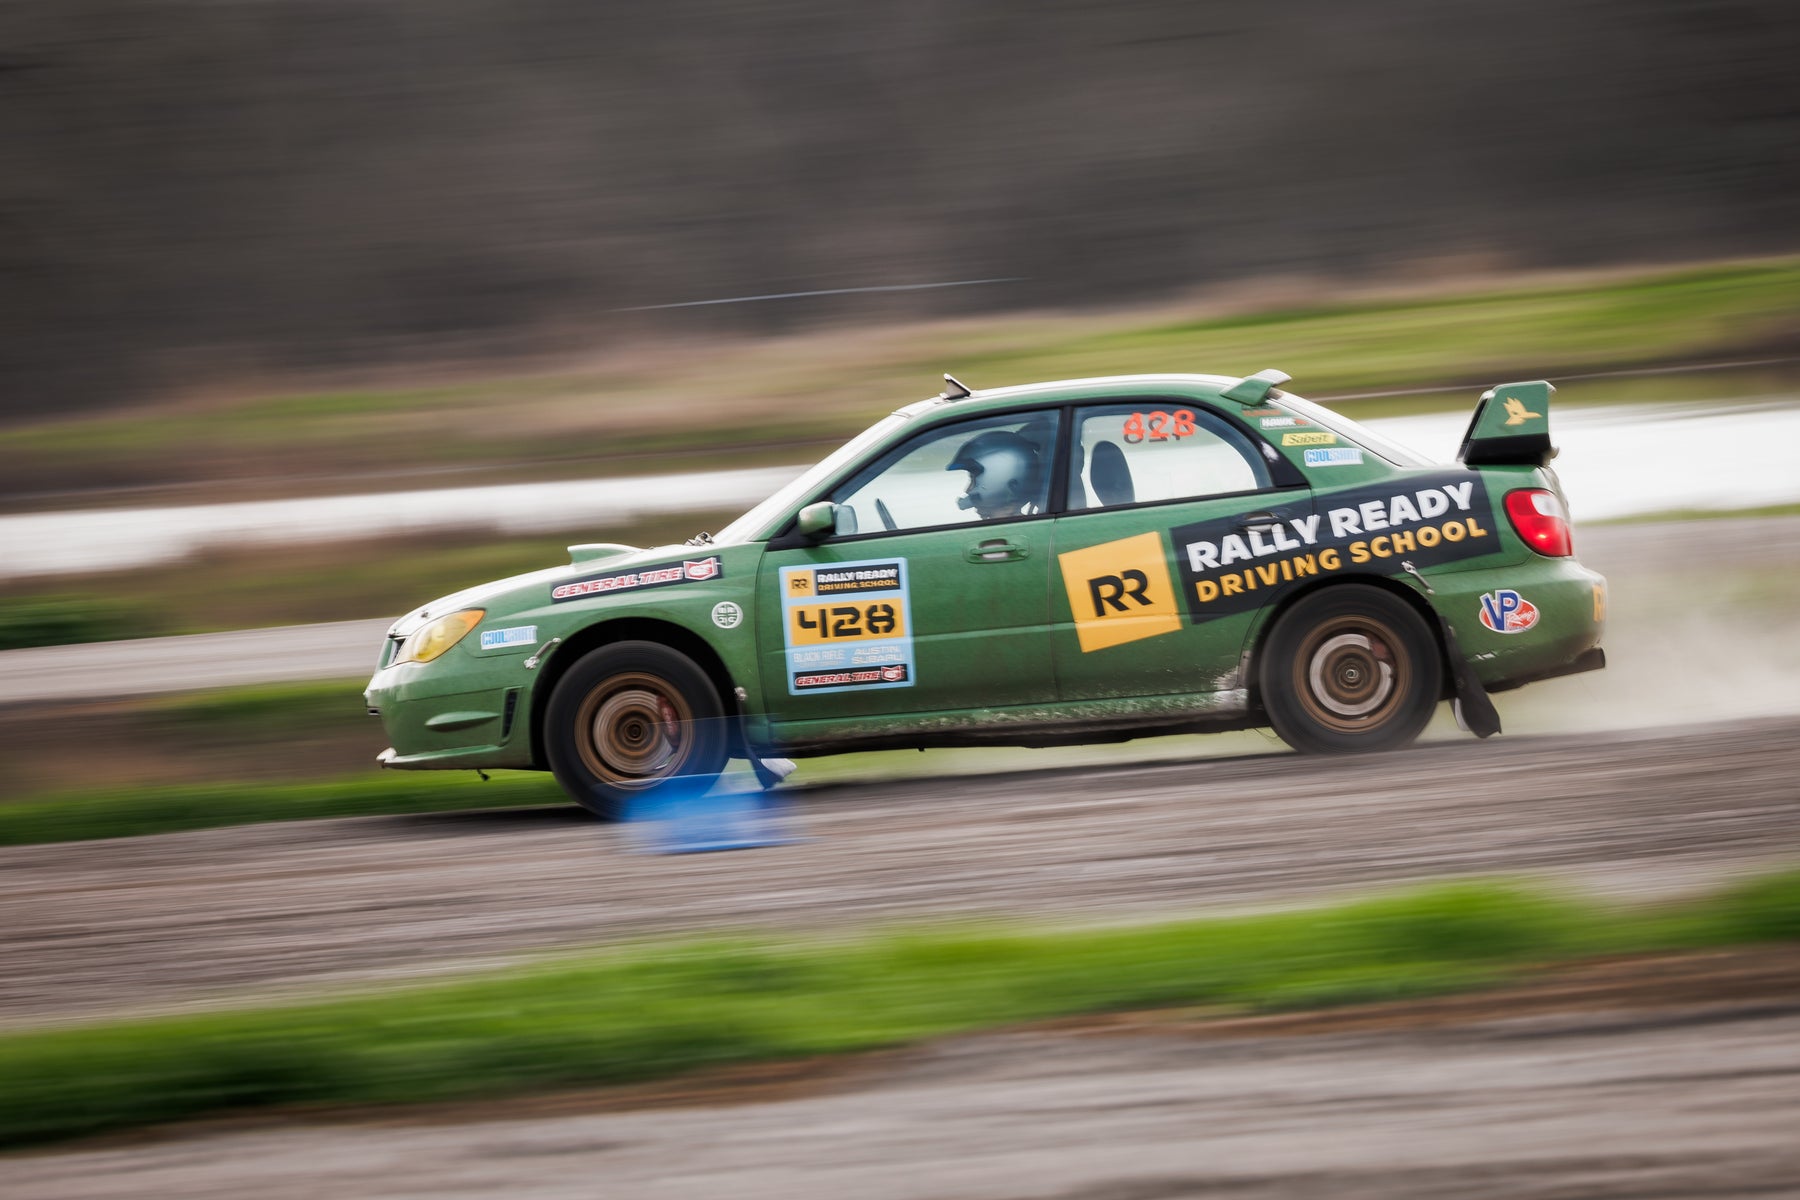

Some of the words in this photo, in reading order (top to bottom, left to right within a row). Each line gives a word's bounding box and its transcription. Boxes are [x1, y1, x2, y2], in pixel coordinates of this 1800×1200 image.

[1122, 409, 1196, 439] 428
[1186, 514, 1321, 572] RALLY
[1328, 481, 1473, 537] READY
[817, 572, 855, 582] RALLY
[856, 569, 898, 580] READY
[1195, 548, 1342, 602] DRIVING
[1349, 517, 1488, 563] SCHOOL
[552, 574, 639, 599] GENERAL
[639, 567, 684, 584] TIRE
[818, 582, 858, 591] DRIVING
[860, 579, 899, 588] SCHOOL
[1088, 568, 1154, 617] RR
[797, 604, 896, 638] 428
[1480, 590, 1520, 631] VP
[795, 673, 850, 686] GENERAL
[852, 671, 881, 681] TIRE
